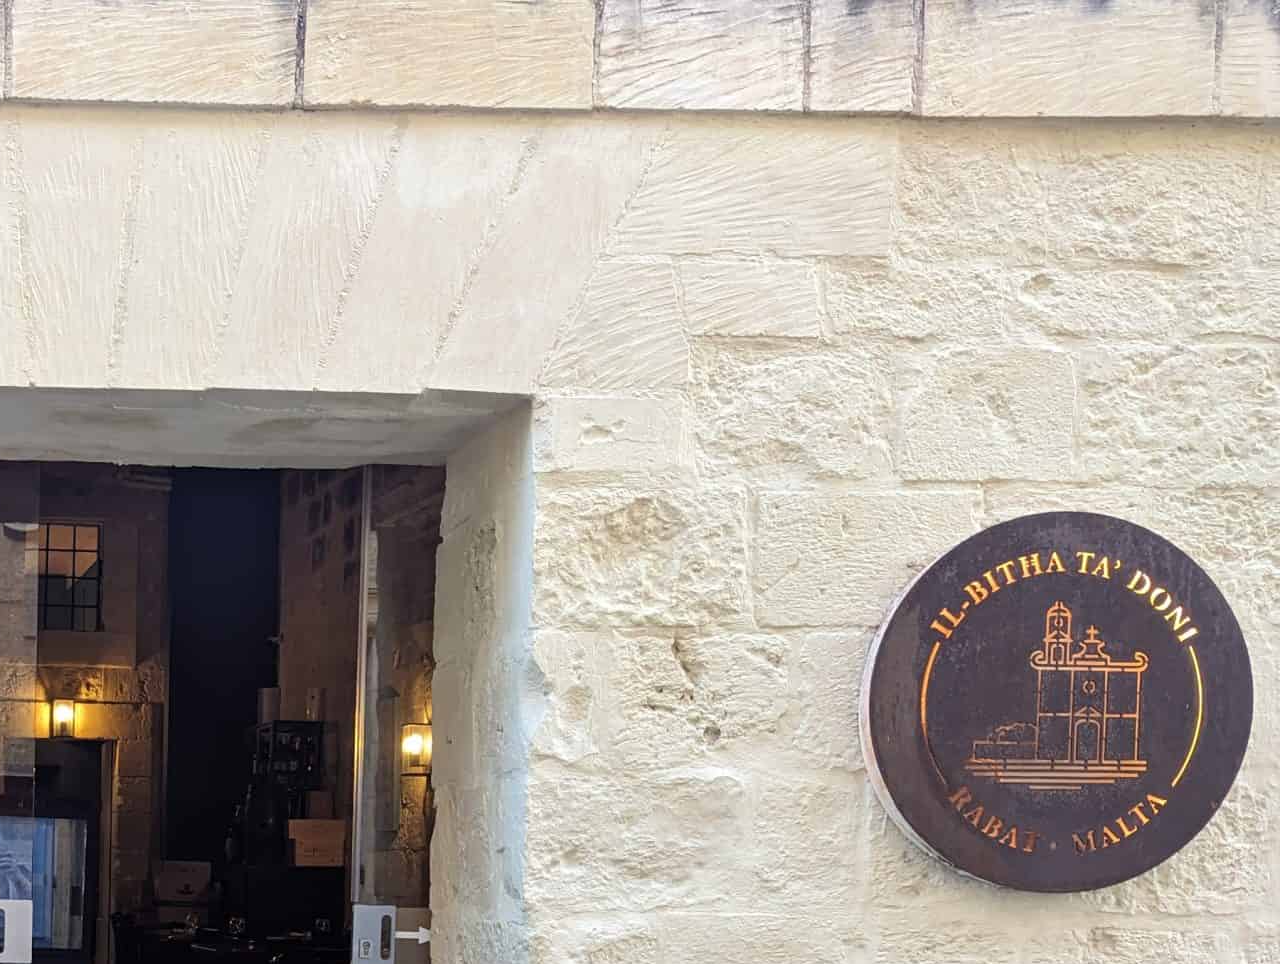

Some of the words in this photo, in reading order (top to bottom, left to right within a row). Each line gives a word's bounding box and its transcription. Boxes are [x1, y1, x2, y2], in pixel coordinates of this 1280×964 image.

[1076, 551, 1121, 579] TA'
[1126, 569, 1199, 642] DONI
[949, 784, 1041, 854] RABAT
[1071, 792, 1169, 856] MALTA
